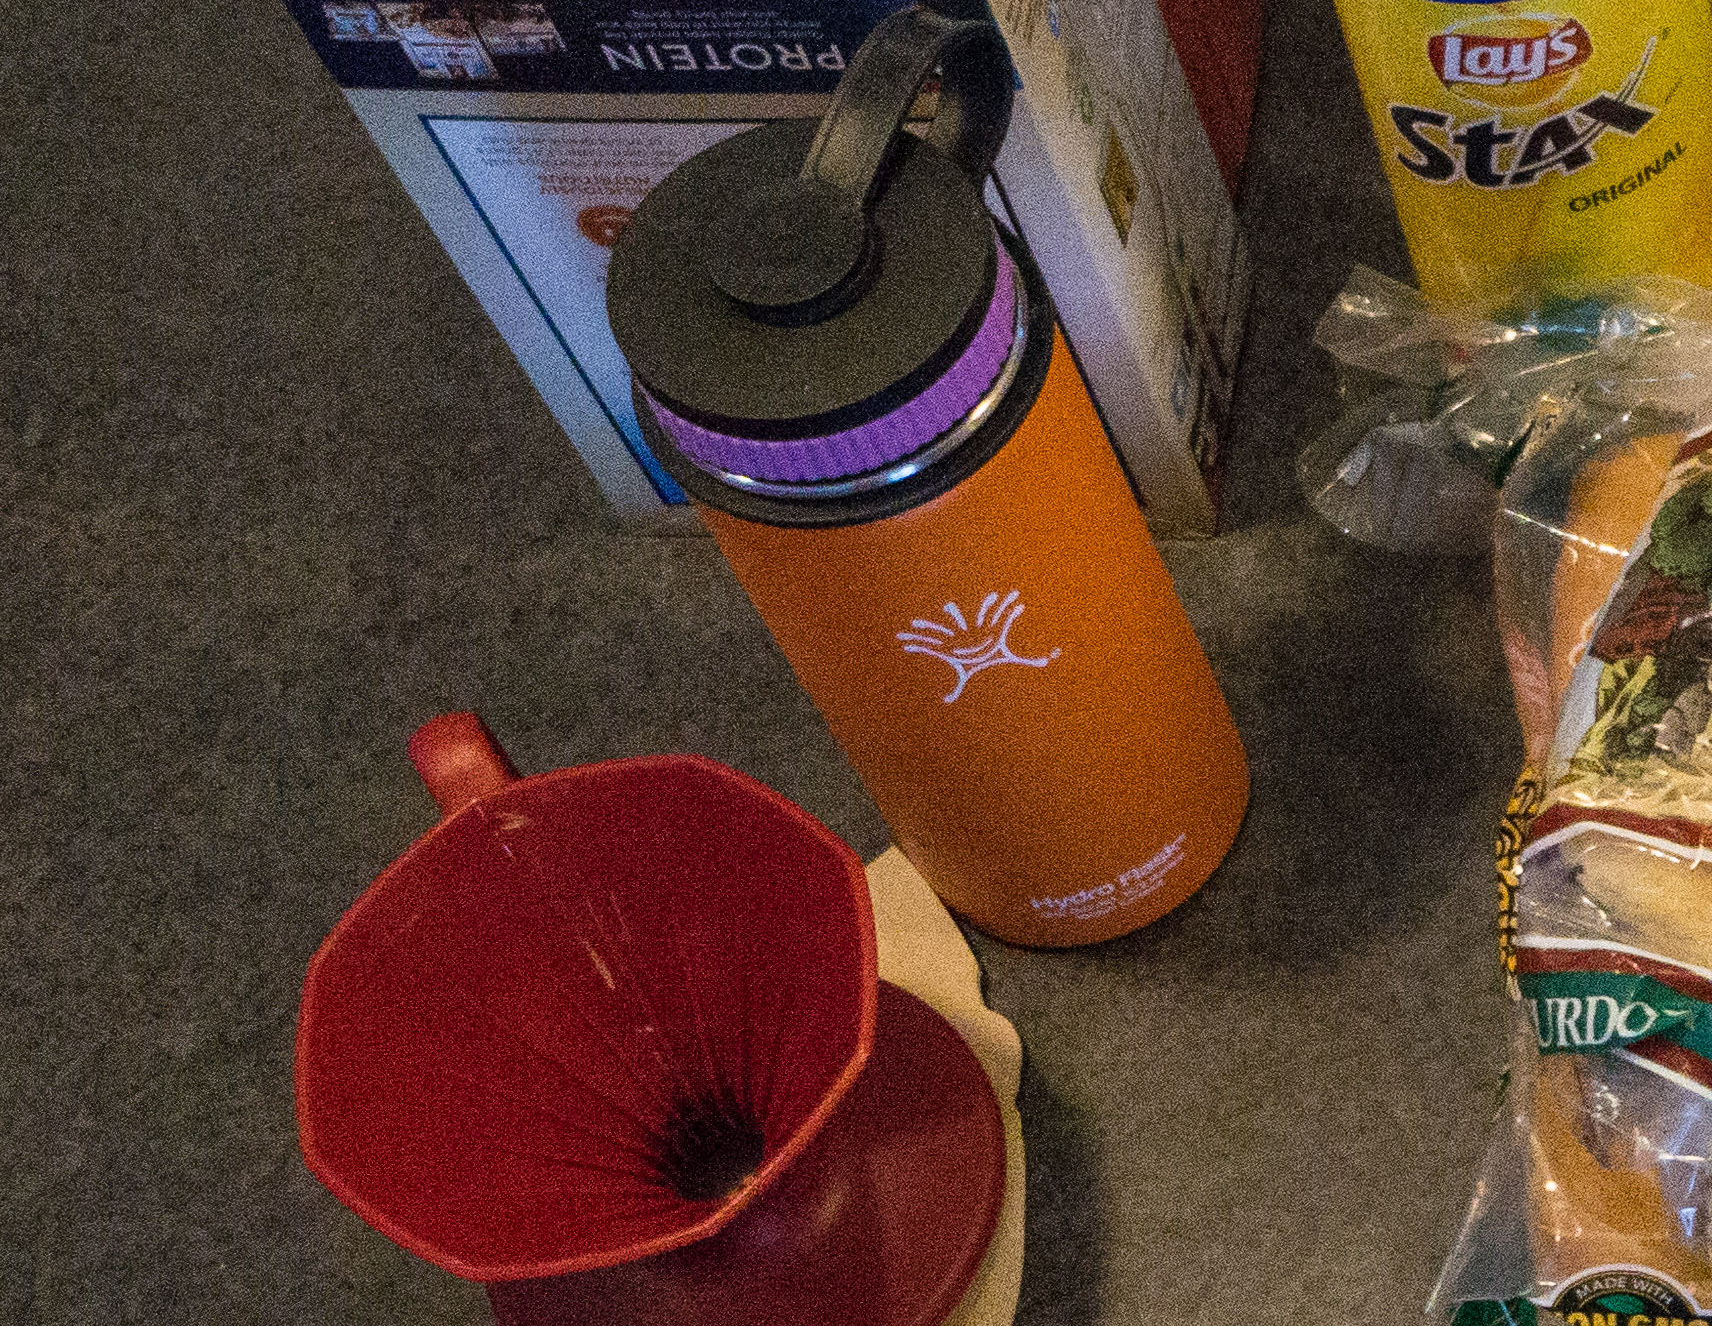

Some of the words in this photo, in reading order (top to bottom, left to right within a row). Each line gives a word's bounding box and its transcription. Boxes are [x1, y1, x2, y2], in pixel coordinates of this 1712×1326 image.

[601, 43, 848, 73] PROTEIN
[1567, 141, 1689, 215] ORIGINAL
[1031, 882, 1117, 910] Hydro
[1576, 1274, 1629, 1306] MADE
[1630, 1276, 1677, 1310] WITH
